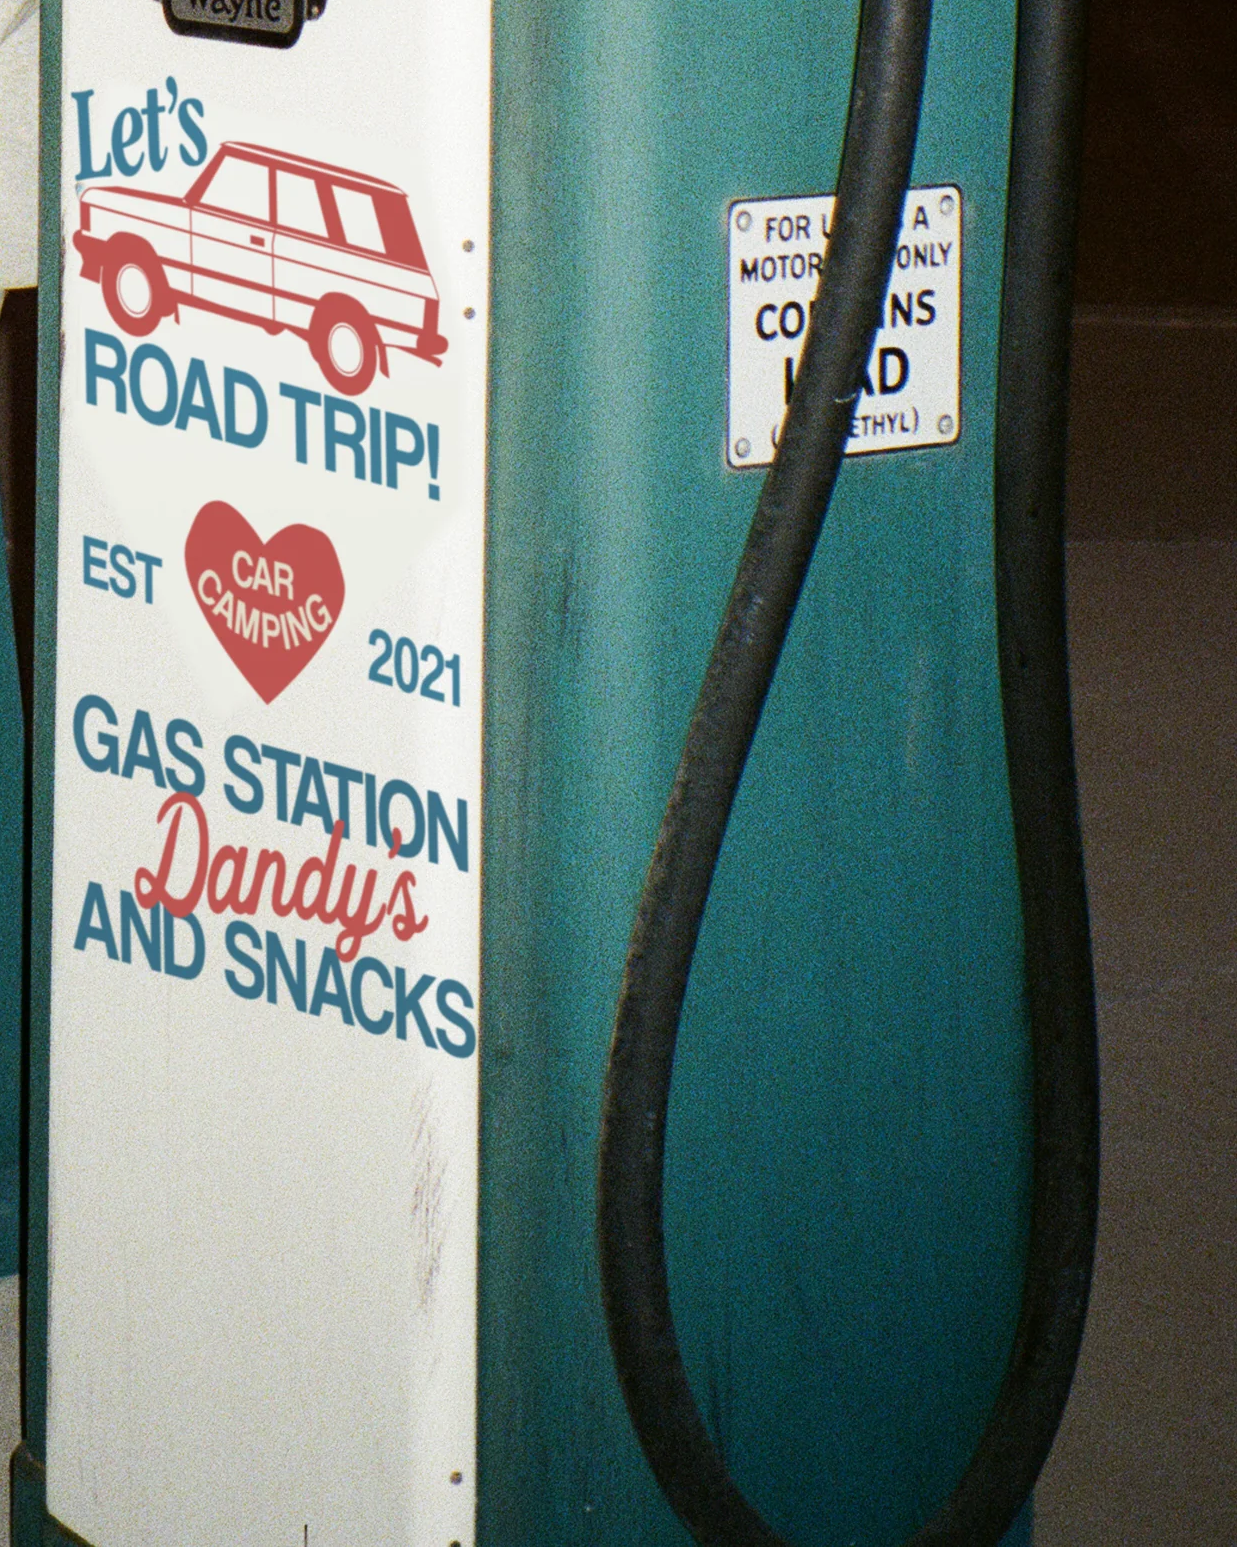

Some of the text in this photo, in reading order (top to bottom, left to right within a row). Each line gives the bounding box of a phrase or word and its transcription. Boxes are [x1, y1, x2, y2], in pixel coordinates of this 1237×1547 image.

[71, 76, 208, 181] Let's
[740, 242, 952, 283] MOTOR ONLY
[765, 215, 812, 243] FOR
[913, 206, 929, 230] A
[84, 328, 441, 501] ROAD TRIP!
[82, 536, 462, 707] EST 2021
[197, 569, 334, 650] CAMPING
[231, 550, 294, 600] CAR
[73, 694, 469, 872] GAS STATION
[134, 791, 429, 963] Dandy's
[74, 881, 476, 1059] AND SNACKS
